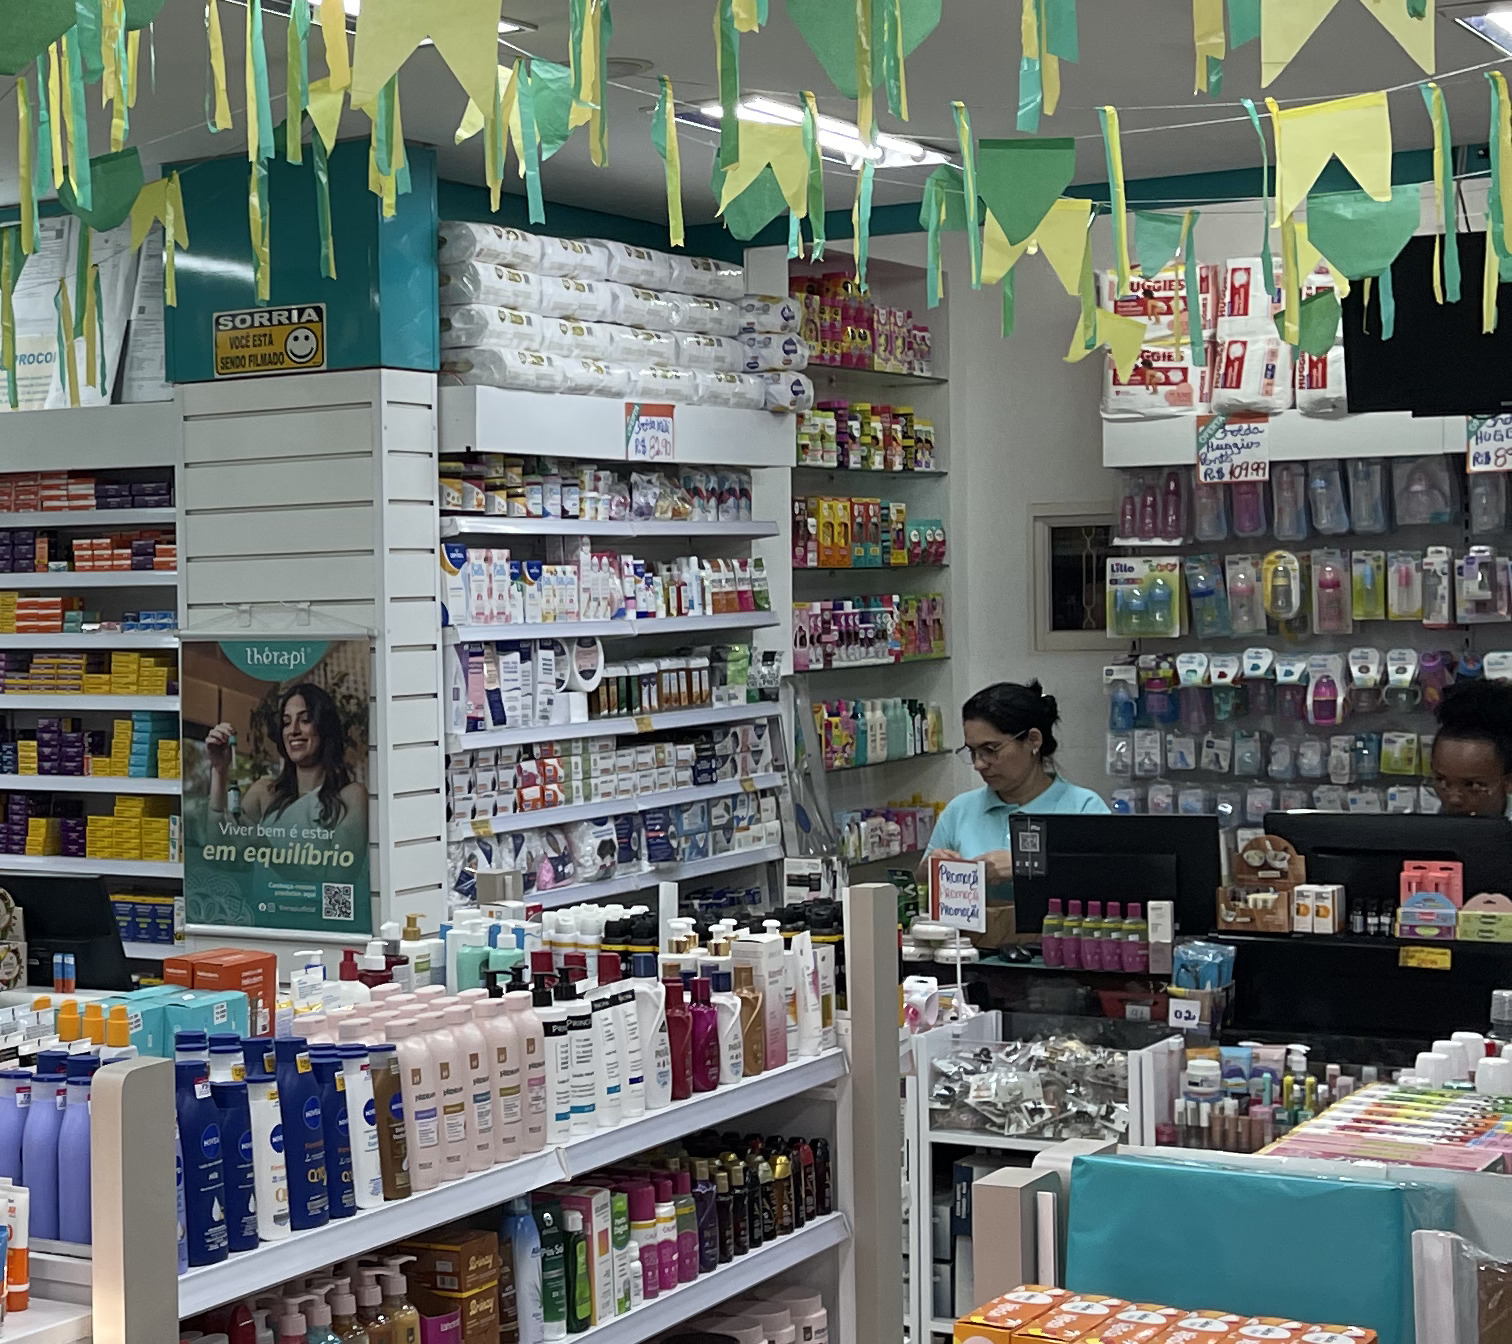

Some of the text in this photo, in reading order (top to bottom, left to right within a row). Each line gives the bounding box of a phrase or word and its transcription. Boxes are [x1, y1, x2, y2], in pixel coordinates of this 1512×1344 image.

[1129, 278, 1186, 294] UGGIES
[218, 308, 320, 331] SORRIA
[220, 352, 285, 370] SENDO FILMADO
[218, 821, 336, 841] Viver bem é estar
[203, 841, 355, 869] em equilíbrio
[1174, 1009, 1196, 1021] 02
